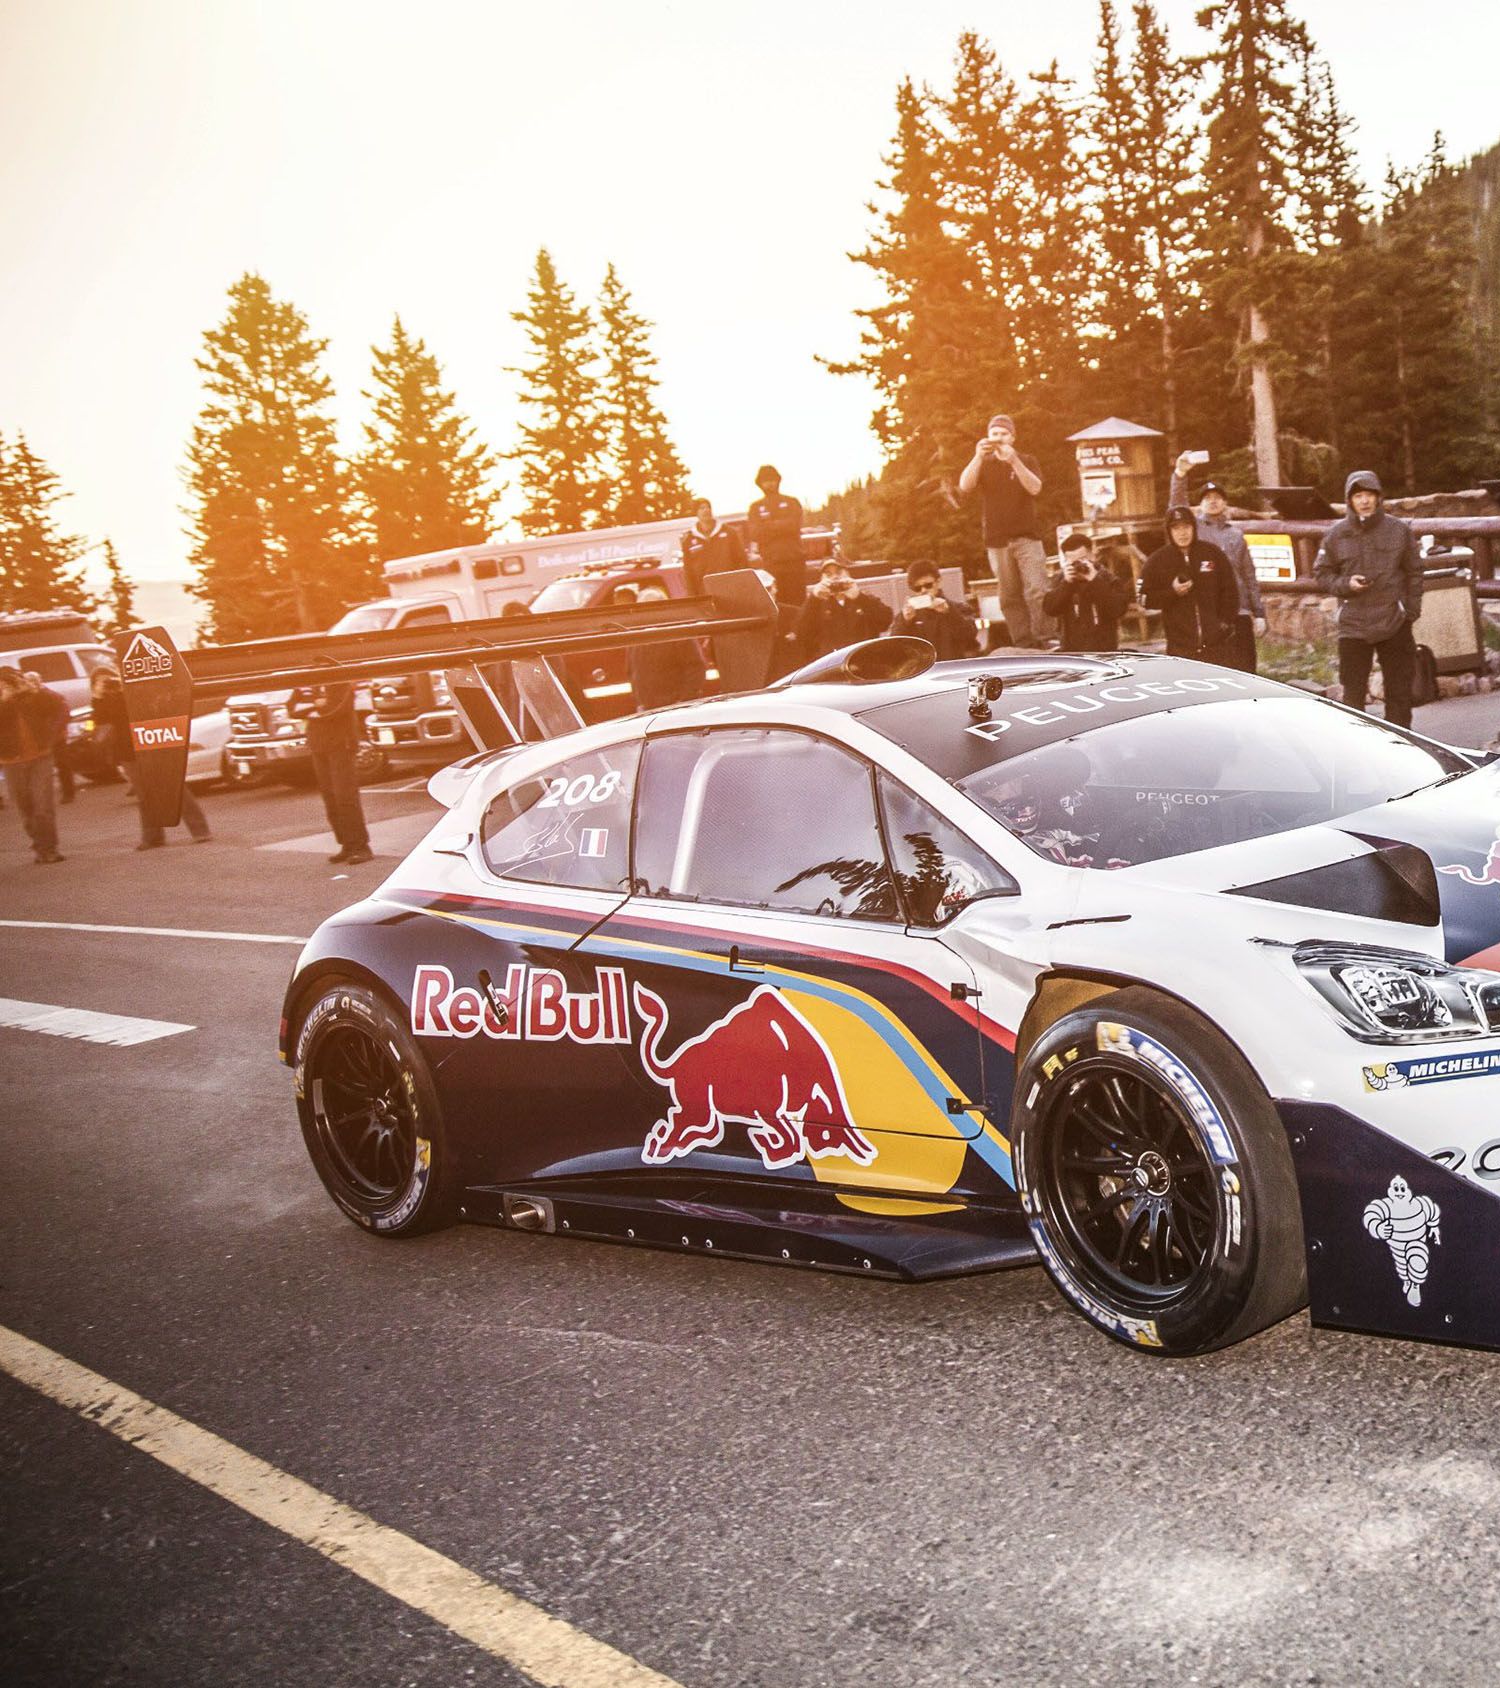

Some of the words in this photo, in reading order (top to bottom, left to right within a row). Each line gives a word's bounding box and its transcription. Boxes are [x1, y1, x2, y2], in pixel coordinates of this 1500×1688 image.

[122, 654, 172, 677] PPIHC
[964, 677, 1248, 742] PEUGEOT
[134, 727, 183, 744] TOTAL
[537, 771, 621, 808] 208
[412, 965, 525, 1038] Red
[526, 967, 632, 1044] Bull
